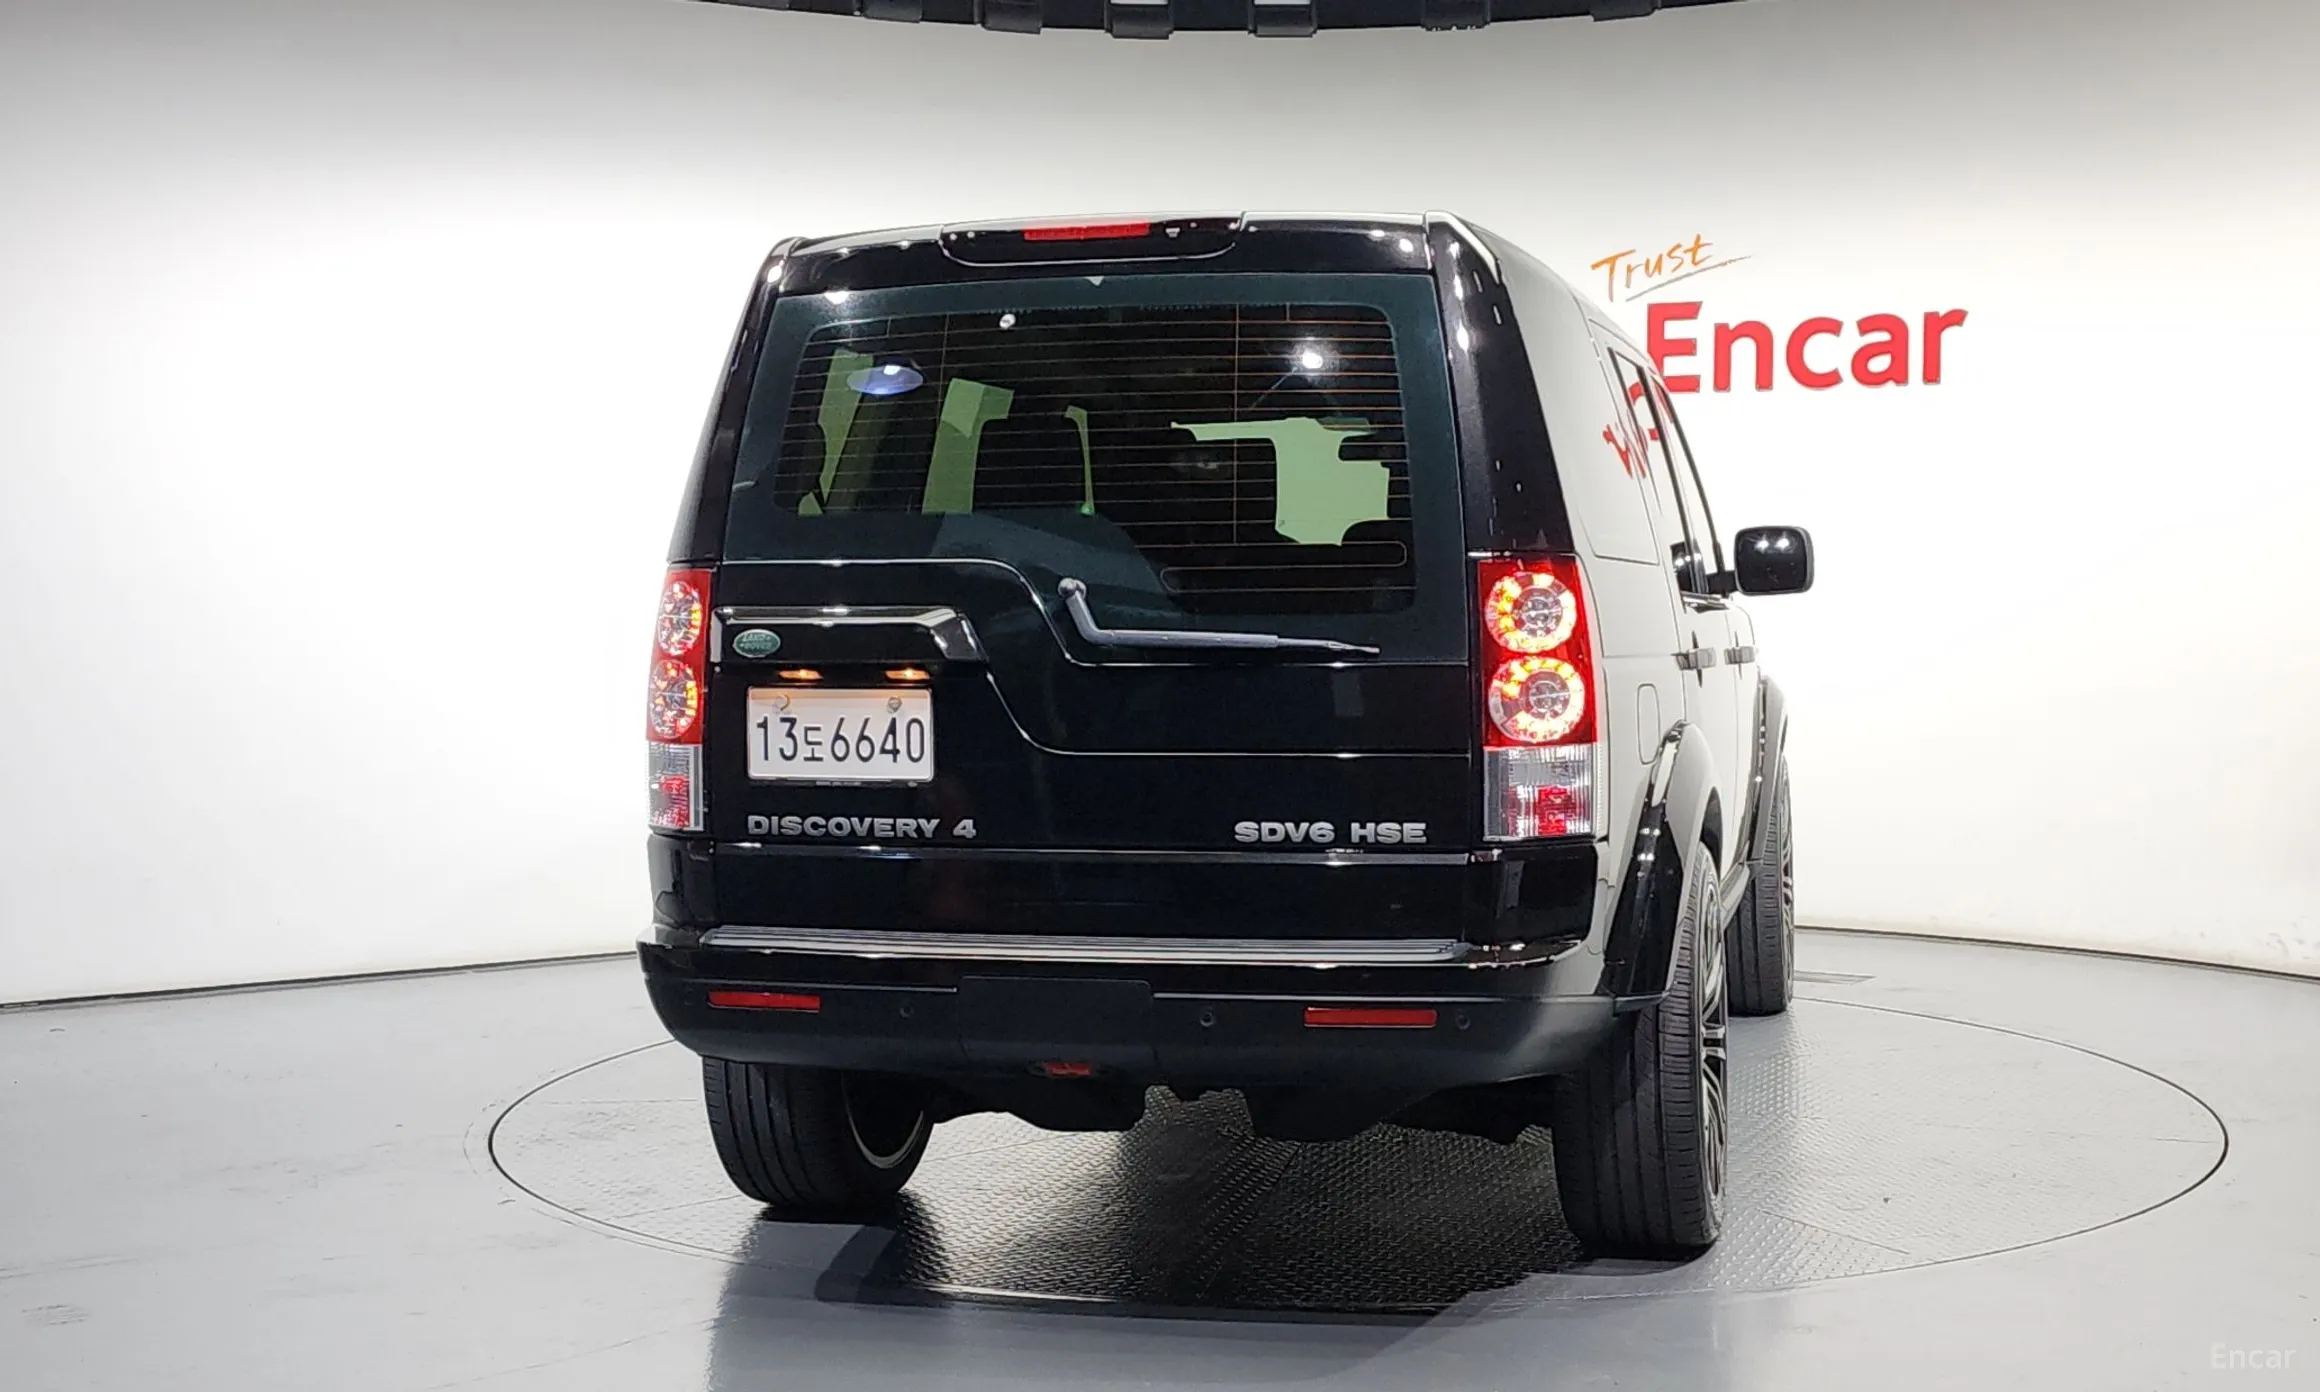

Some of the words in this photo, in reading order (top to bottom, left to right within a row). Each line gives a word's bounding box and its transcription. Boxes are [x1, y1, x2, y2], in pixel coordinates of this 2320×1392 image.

[1590, 234, 1713, 303] Trust
[1646, 300, 1969, 394] Encar
[747, 815, 940, 838] DISCOVERY
[952, 818, 977, 839] 4
[1234, 820, 1335, 844] SDV6
[1350, 821, 1427, 844] HSE
